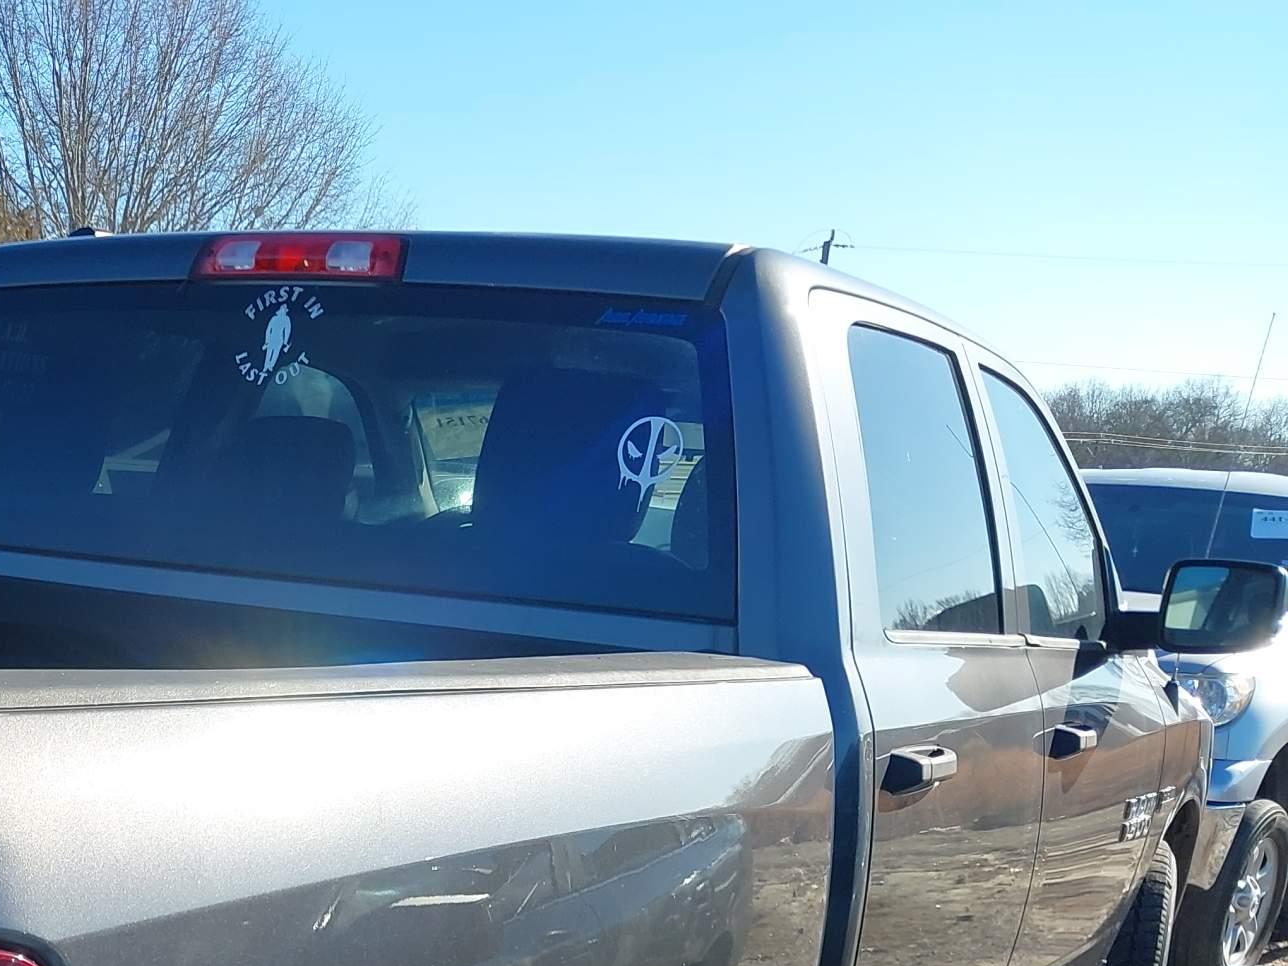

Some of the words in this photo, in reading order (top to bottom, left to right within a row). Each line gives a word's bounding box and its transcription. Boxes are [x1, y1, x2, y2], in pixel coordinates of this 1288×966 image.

[245, 286, 303, 320] FIRST
[303, 296, 324, 319] IN
[235, 352, 268, 385] LAST
[275, 352, 310, 385] OUT
